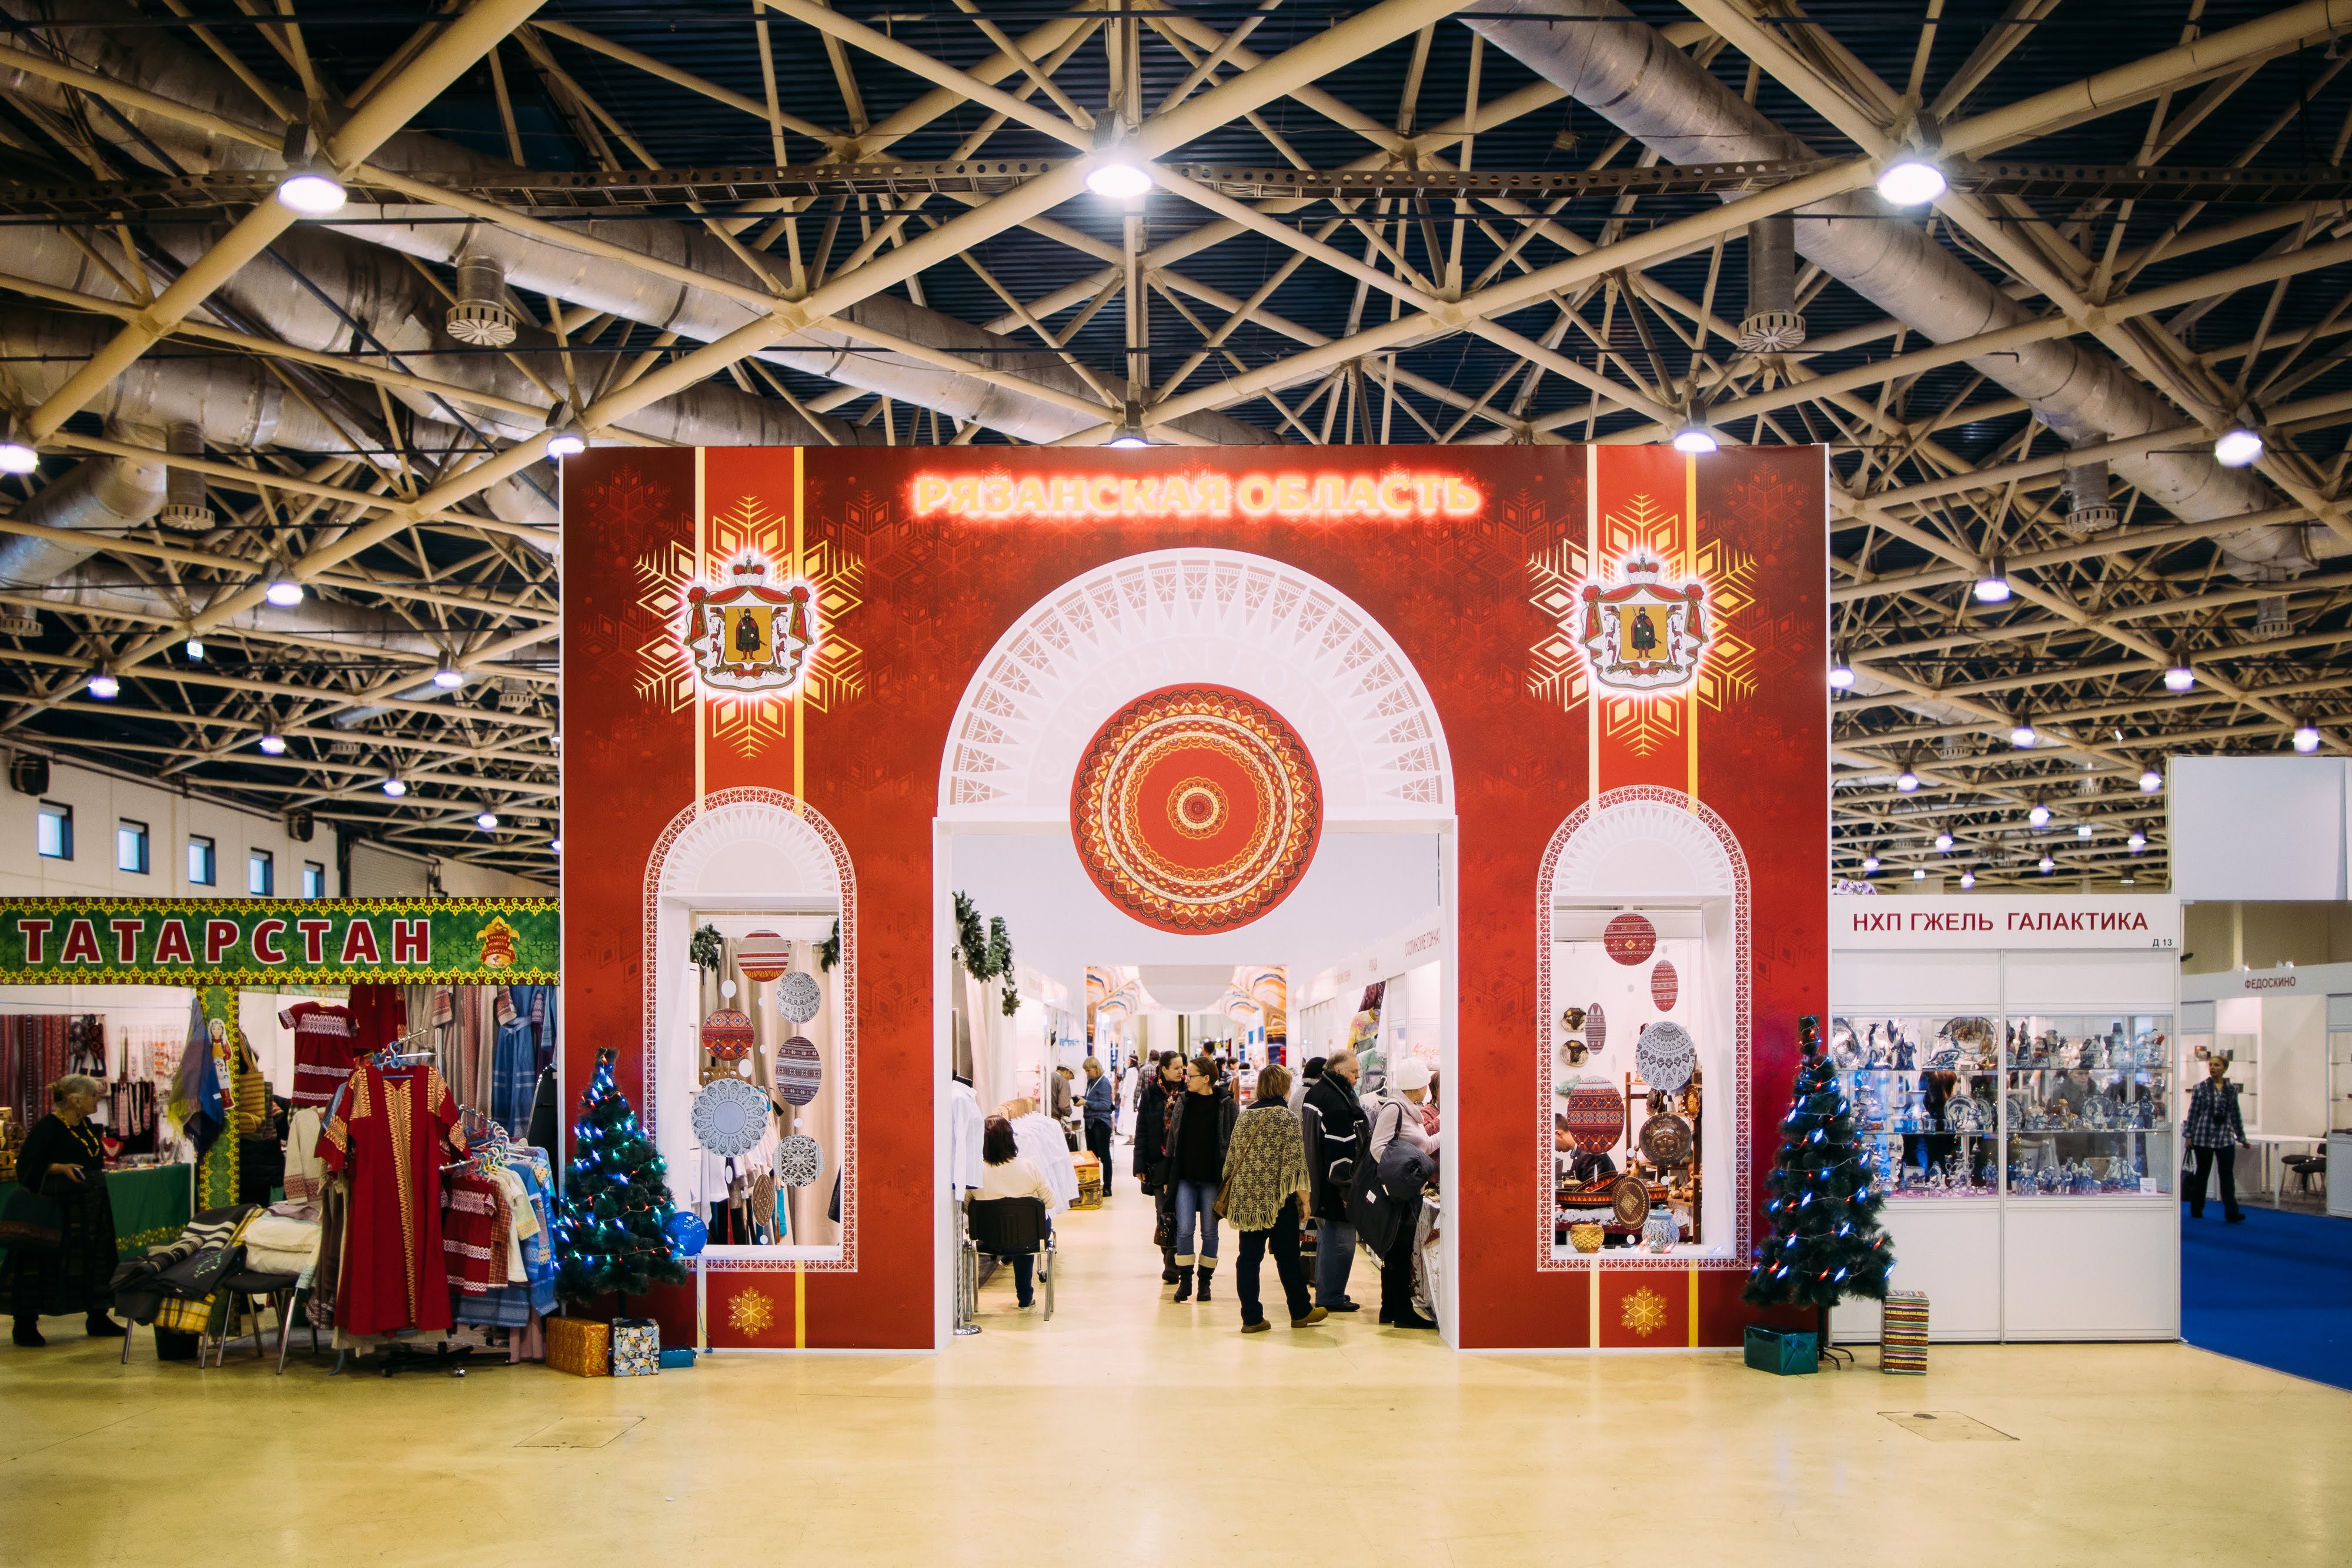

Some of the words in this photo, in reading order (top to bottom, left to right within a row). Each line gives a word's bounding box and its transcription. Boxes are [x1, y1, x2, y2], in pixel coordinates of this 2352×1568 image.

[916, 478, 1229, 512] РЯЗАНСКАЯ
[1240, 477, 1479, 511] ОБЛАСТЬ
[1853, 913, 1901, 931] НХП
[1910, 912, 1994, 931] ГЖЕЛЬ
[2007, 912, 2149, 931] ГАЛАКТИКА
[17, 919, 431, 964] ТАТАРСТАН
[2152, 938, 2160, 948] Д
[2244, 977, 2296, 990] ФЕДОСКИНО
